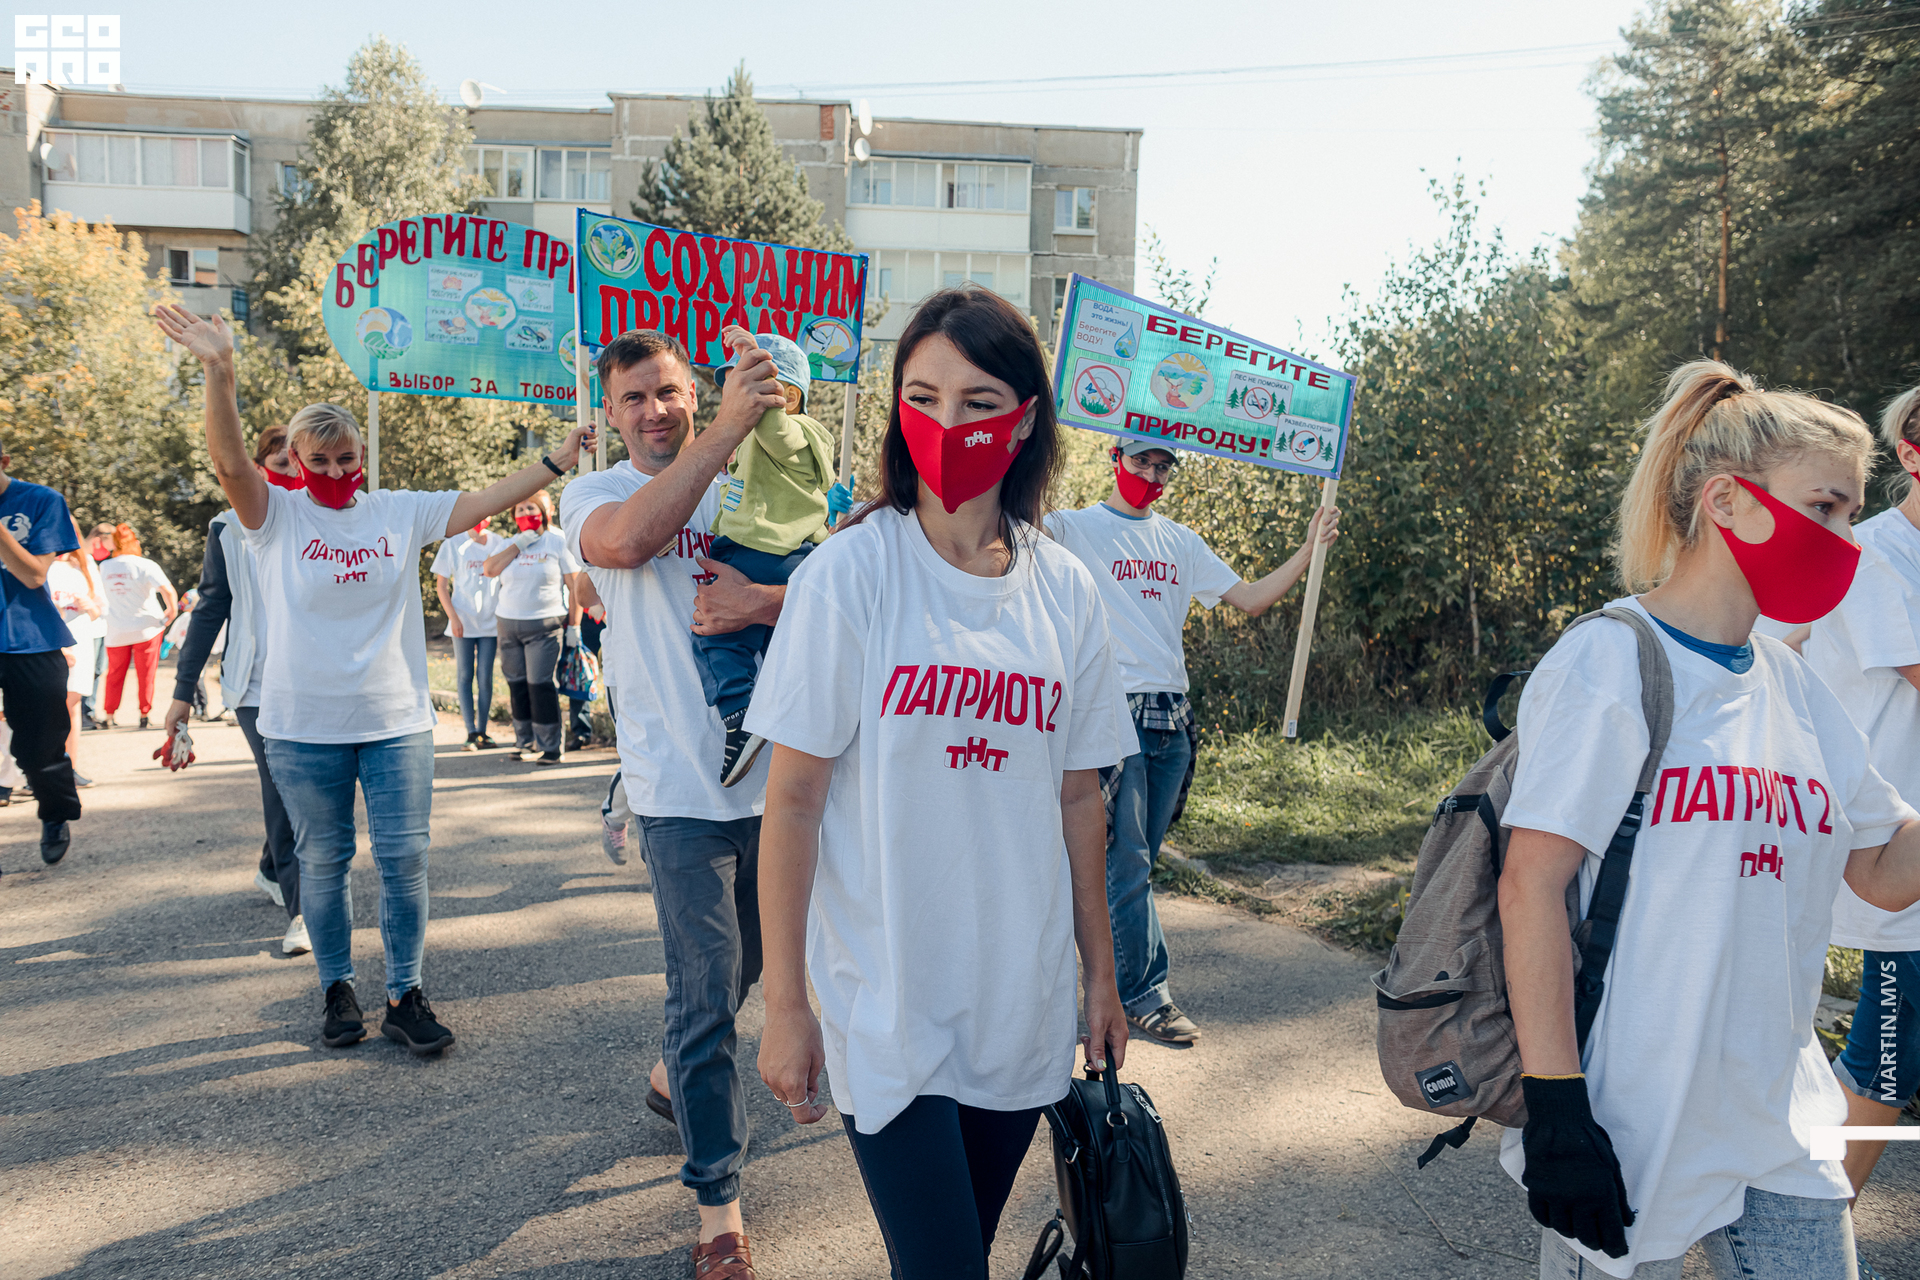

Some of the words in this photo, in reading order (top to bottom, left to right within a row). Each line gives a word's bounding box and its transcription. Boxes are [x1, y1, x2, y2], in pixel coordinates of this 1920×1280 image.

[335, 214, 508, 308] БЕРЕГИТЕ
[523, 229, 575, 293] ПР
[643, 228, 864, 322] СОХРАНИМ
[1092, 302, 1114, 314] ВОДА
[1076, 331, 1104, 346] ВОДУ!
[1078, 321, 1117, 337] Берегите
[1146, 314, 1330, 391] БЕРЕГИТЕ
[389, 371, 455, 391] ВЫБОР
[470, 377, 498, 394] ЗА
[520, 382, 577, 401] ТОБОЙ
[1247, 376, 1257, 384] НЕ
[1124, 411, 1271, 458] ПРИРОДУ!
[377, 536, 394, 557] 2
[1170, 564, 1179, 585] 2
[879, 664, 1046, 733] ПАТРИОТ
[1045, 680, 1062, 732] 2
[1650, 765, 1807, 835] ПАТРИОТ
[1807, 778, 1833, 835] 2
